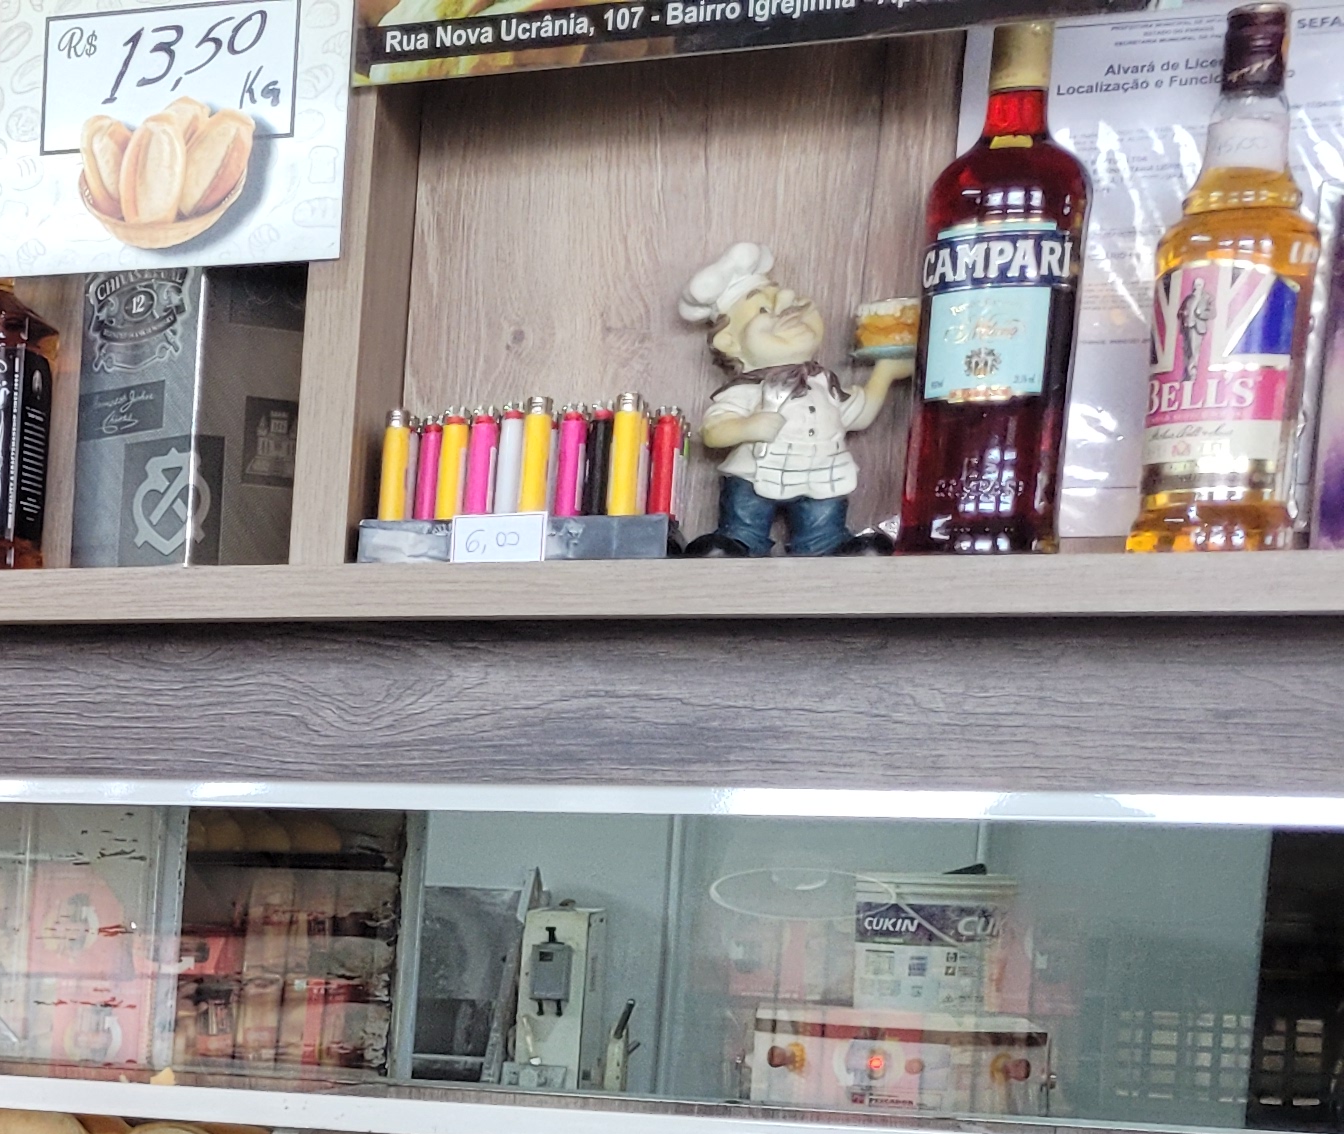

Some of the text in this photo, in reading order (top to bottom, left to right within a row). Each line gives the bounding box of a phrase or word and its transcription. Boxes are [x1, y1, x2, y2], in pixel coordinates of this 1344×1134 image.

[385, 31, 428, 52] Rua
[436, 25, 493, 48] Nova
[500, 15, 595, 42] Ucrânia,
[604, 6, 644, 31] 107
[666, 1, 741, 26] Bairro
[1297, 16, 1344, 30] SEFA
[57, 10, 267, 104] R$ 13,50
[1104, 61, 1155, 76] Alvará
[1161, 60, 1180, 71] de
[1056, 78, 1149, 97] Localização
[1155, 79, 1164, 88] e
[922, 239, 1074, 290] CAMPARI
[132, 294, 145, 314] 12
[1146, 371, 1255, 416] BELL'S
[466, 529, 520, 555] 6,00
[864, 916, 919, 932] CUKIN
